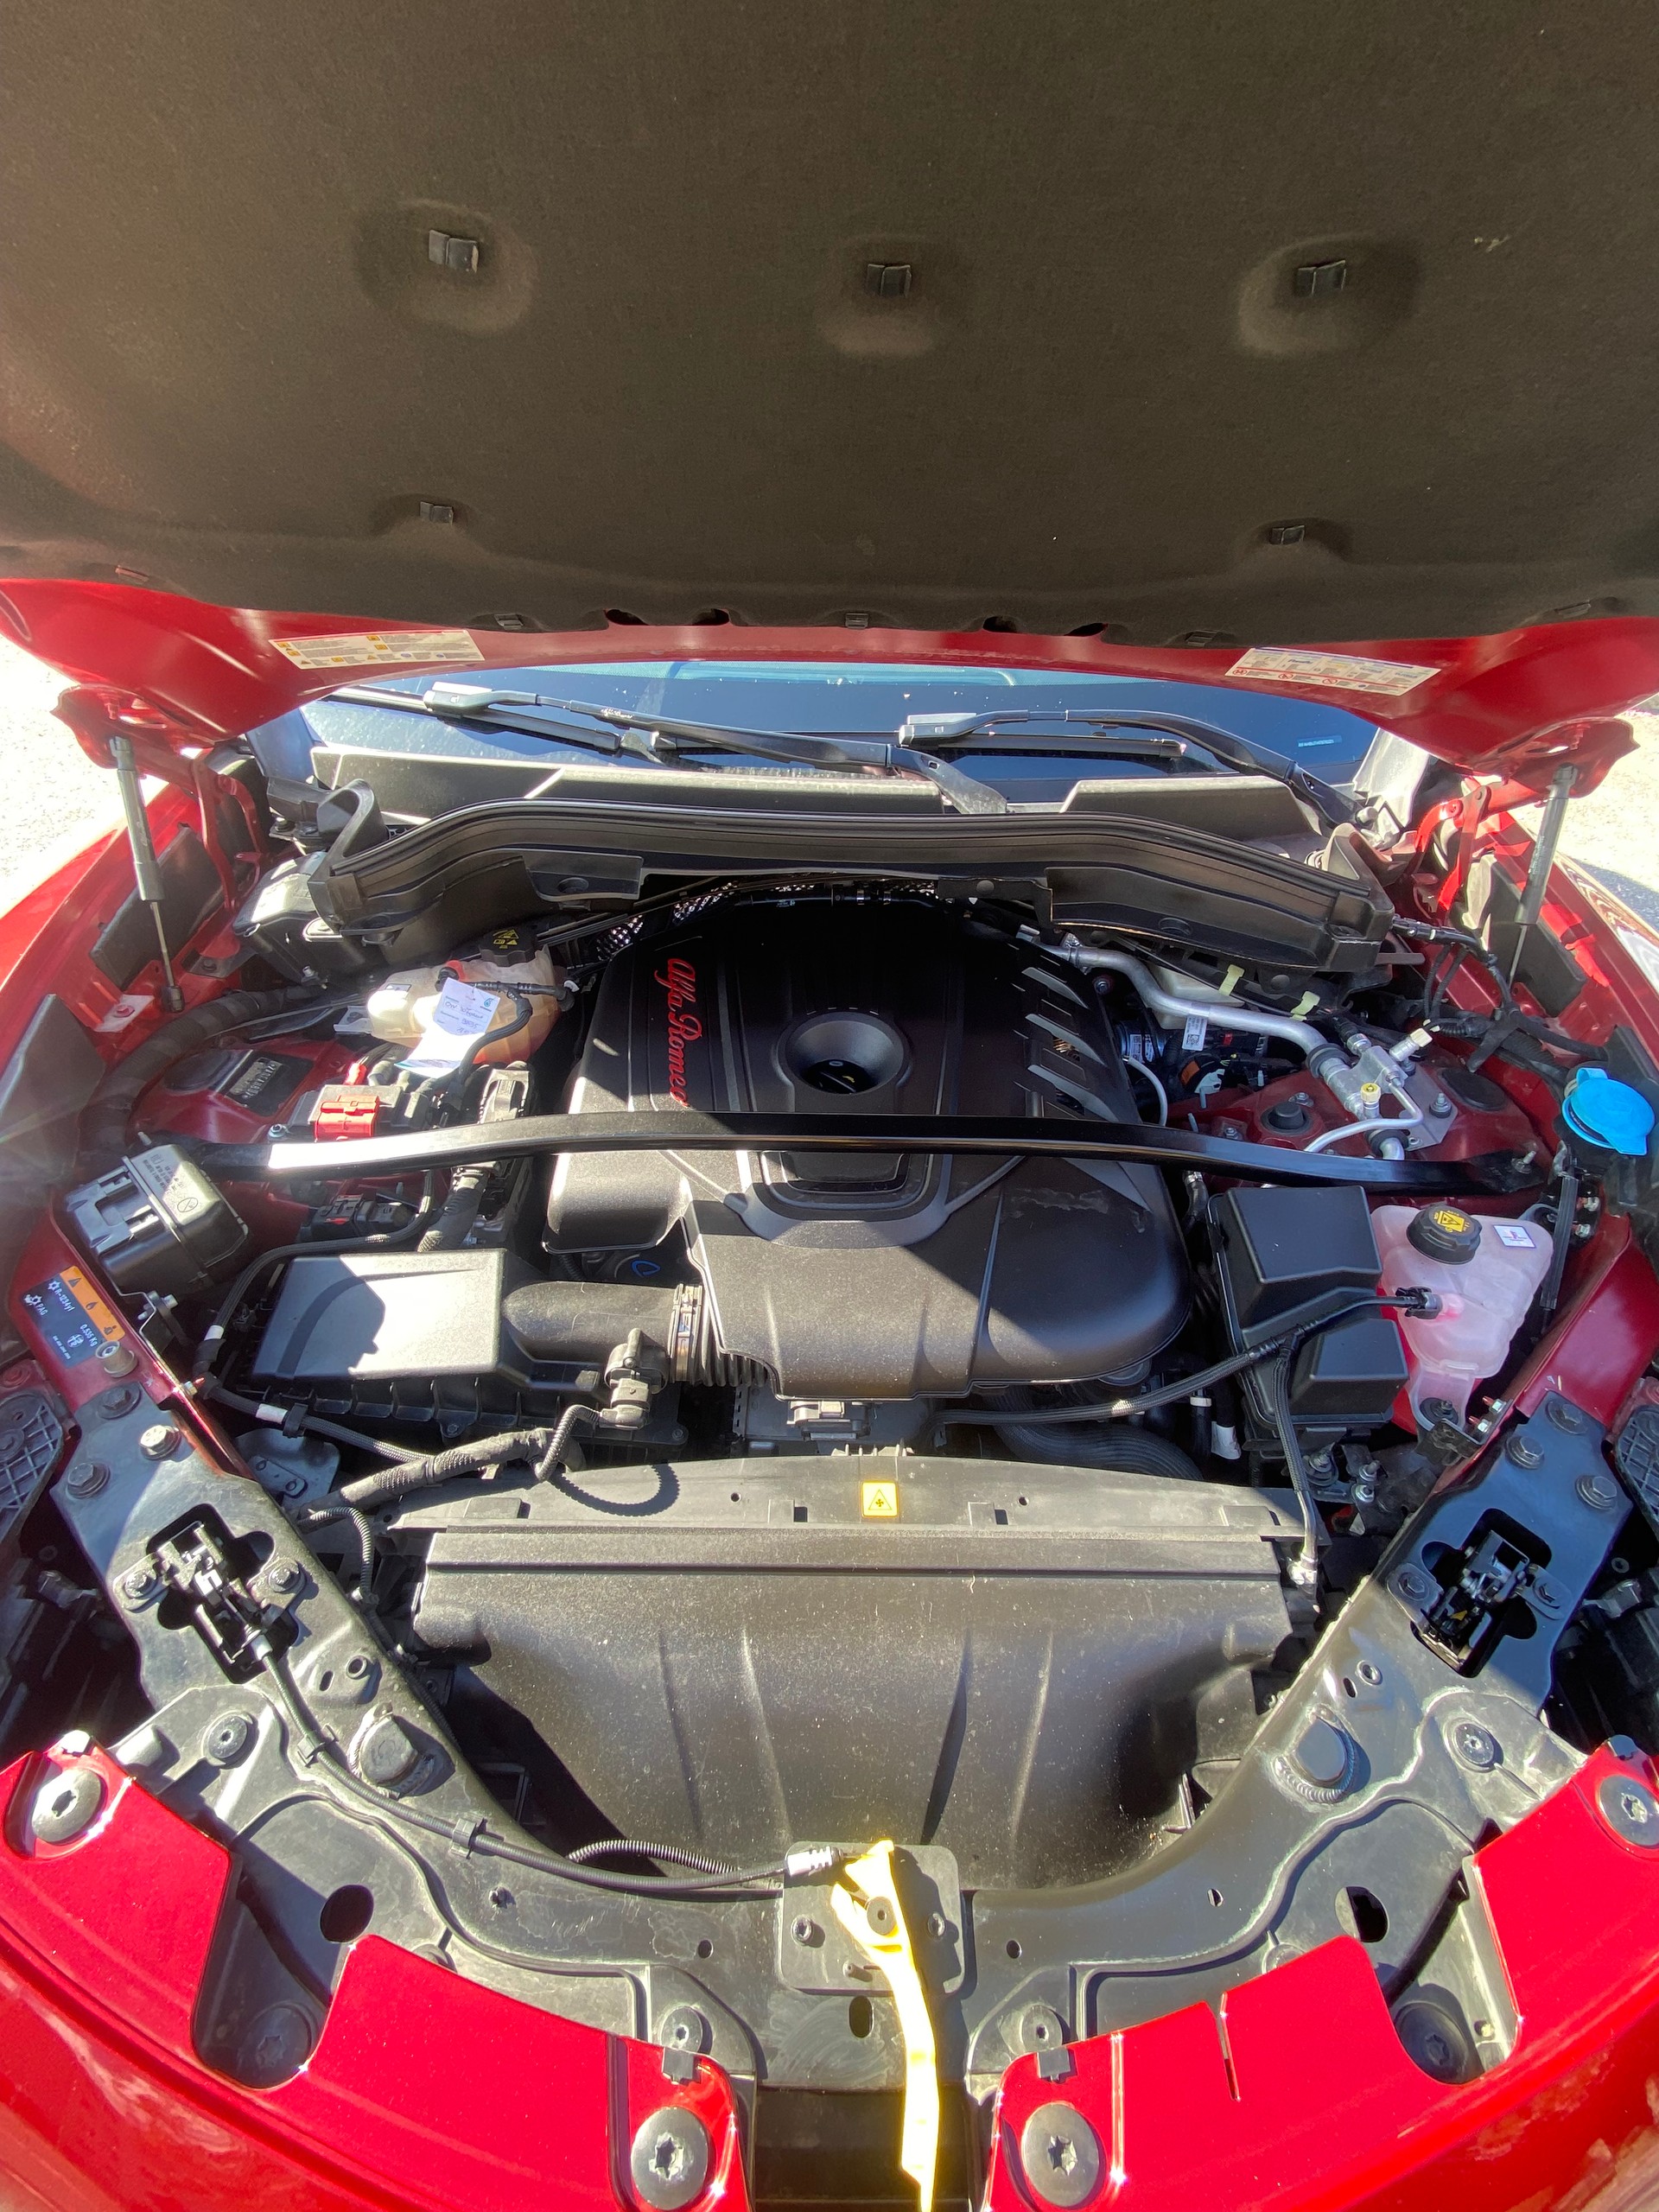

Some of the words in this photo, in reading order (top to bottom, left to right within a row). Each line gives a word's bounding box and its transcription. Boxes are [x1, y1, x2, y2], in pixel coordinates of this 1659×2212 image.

[654, 958, 696, 1012] Alfa
[667, 1011, 702, 1108] Romeo
[35, 1303, 48, 1316] PAG
[88, 1336, 99, 1347] Kg
